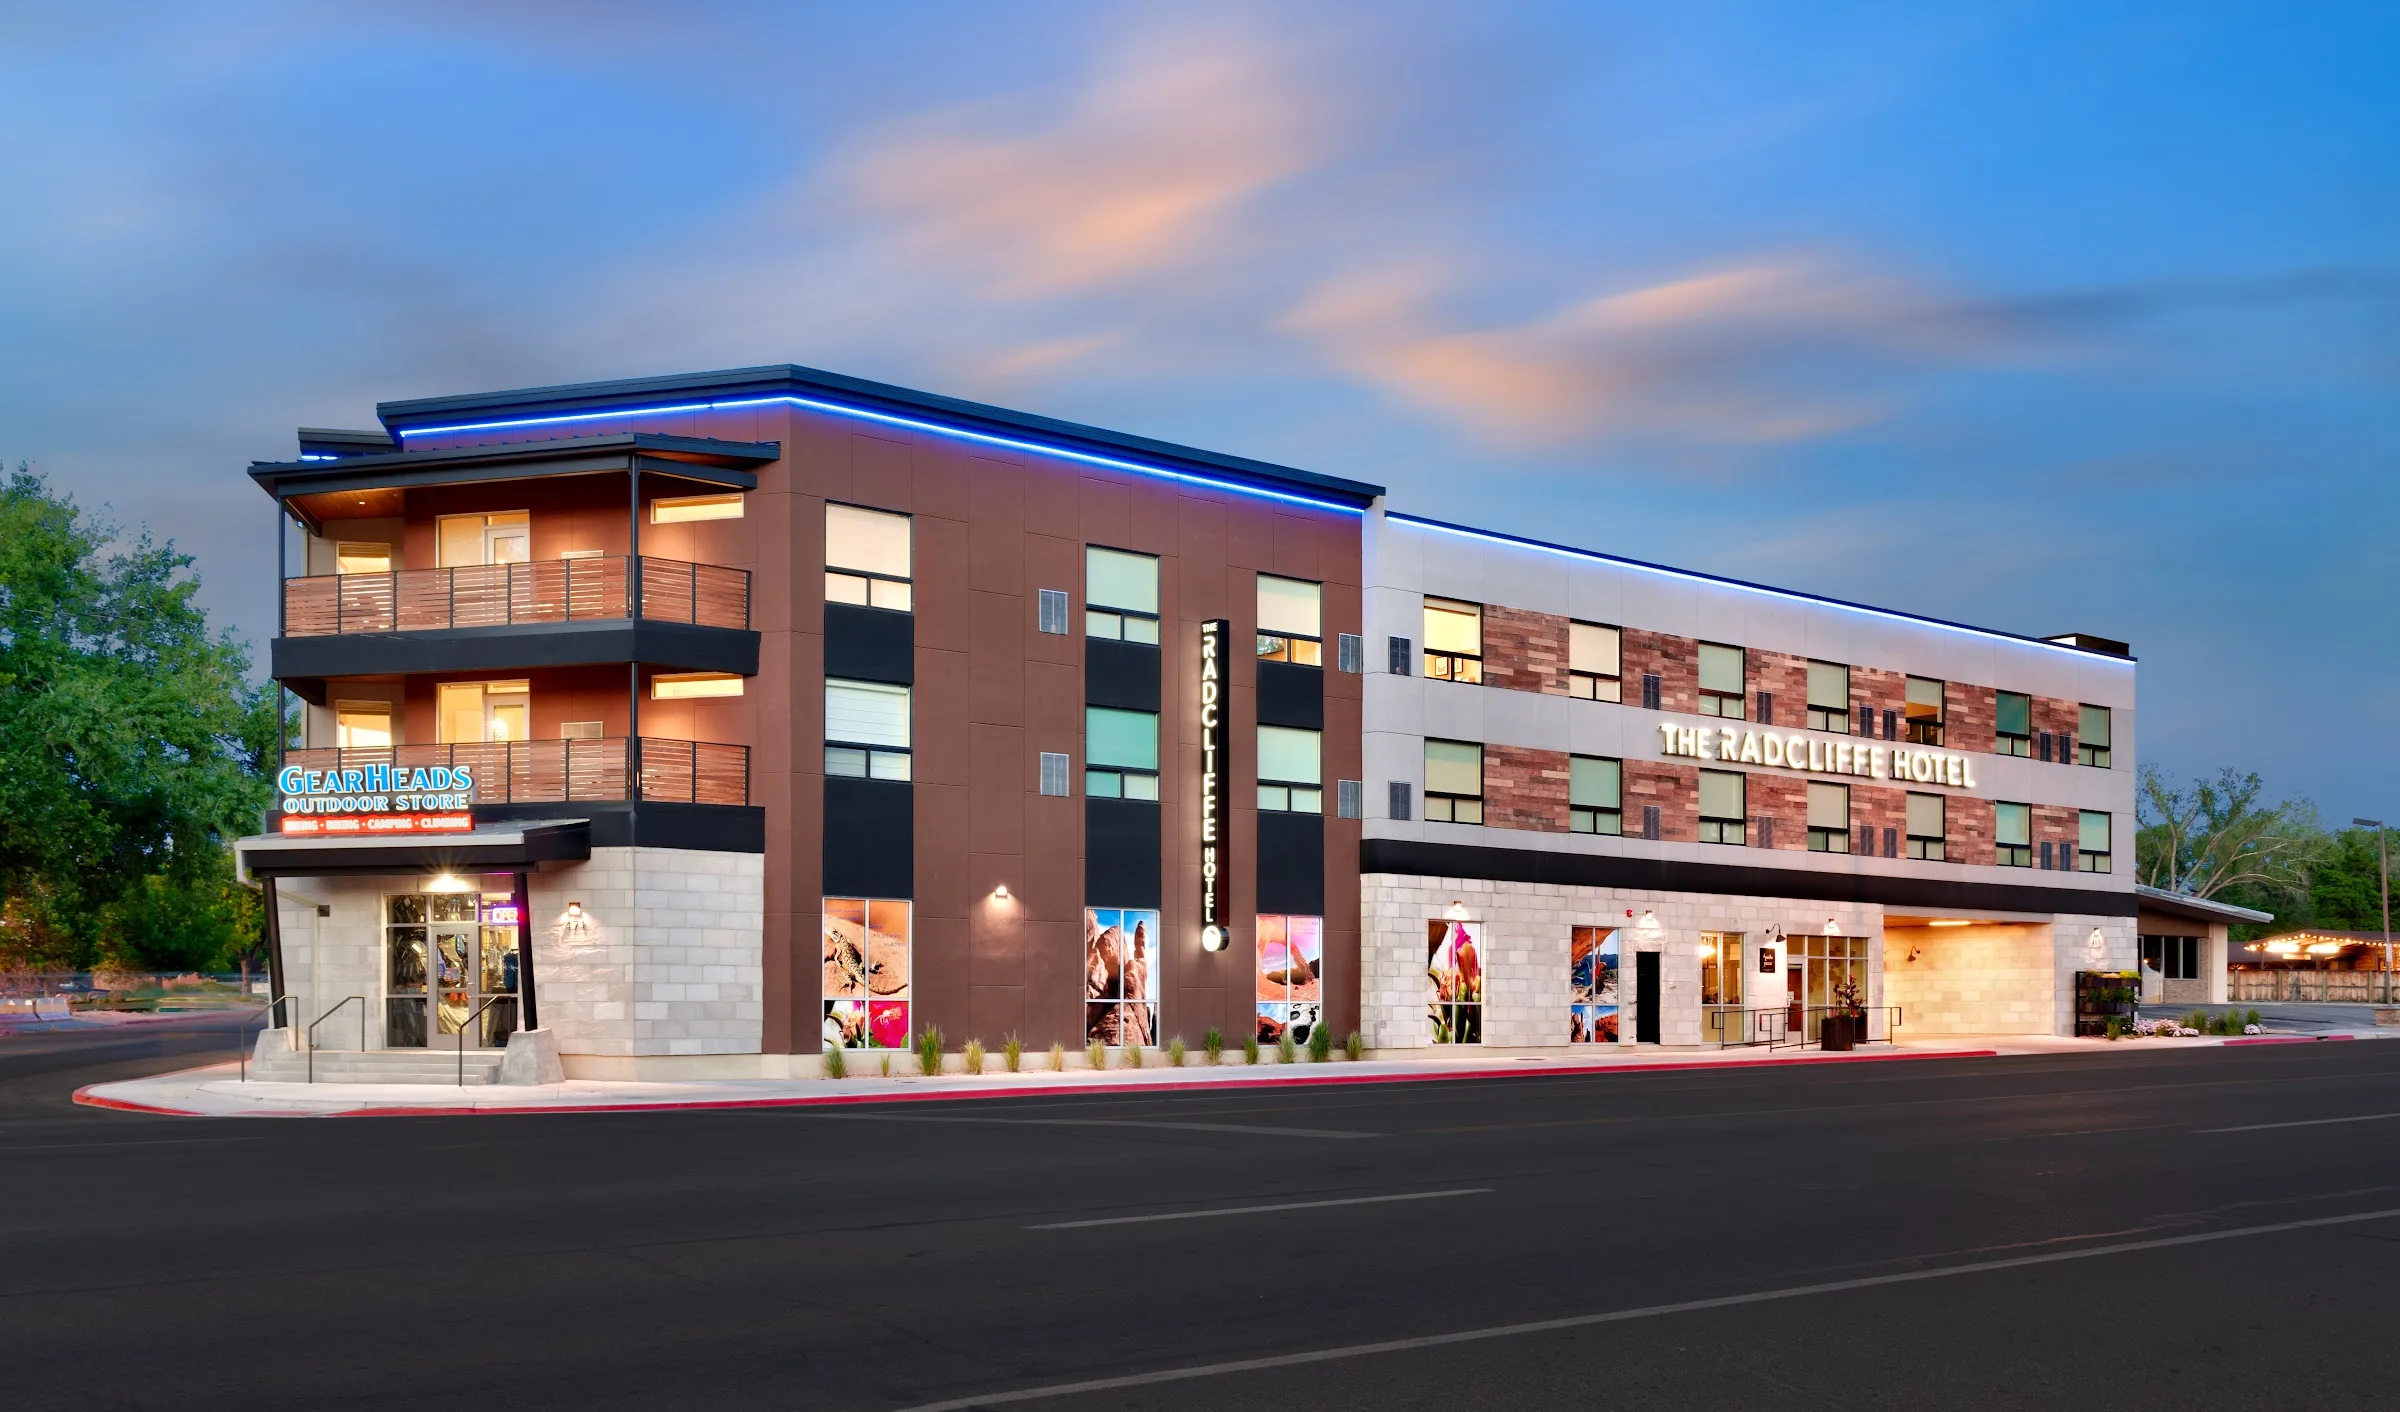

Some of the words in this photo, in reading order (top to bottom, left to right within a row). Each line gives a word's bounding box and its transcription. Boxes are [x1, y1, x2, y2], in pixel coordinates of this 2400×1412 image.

[1202, 622, 1218, 633] THE
[1202, 635, 1218, 842] RADCLIFFE
[1660, 722, 1713, 760] THE
[1716, 726, 1886, 779] RADCLIFFE
[1888, 749, 1977, 788] HOTEL
[283, 795, 390, 814] OUTDOOR
[395, 793, 470, 811] STORE
[366, 817, 413, 830] CAMPING
[420, 816, 470, 829] CLIMBING
[1203, 846, 1217, 924] HOTEL
[565, 921, 586, 931] 471
